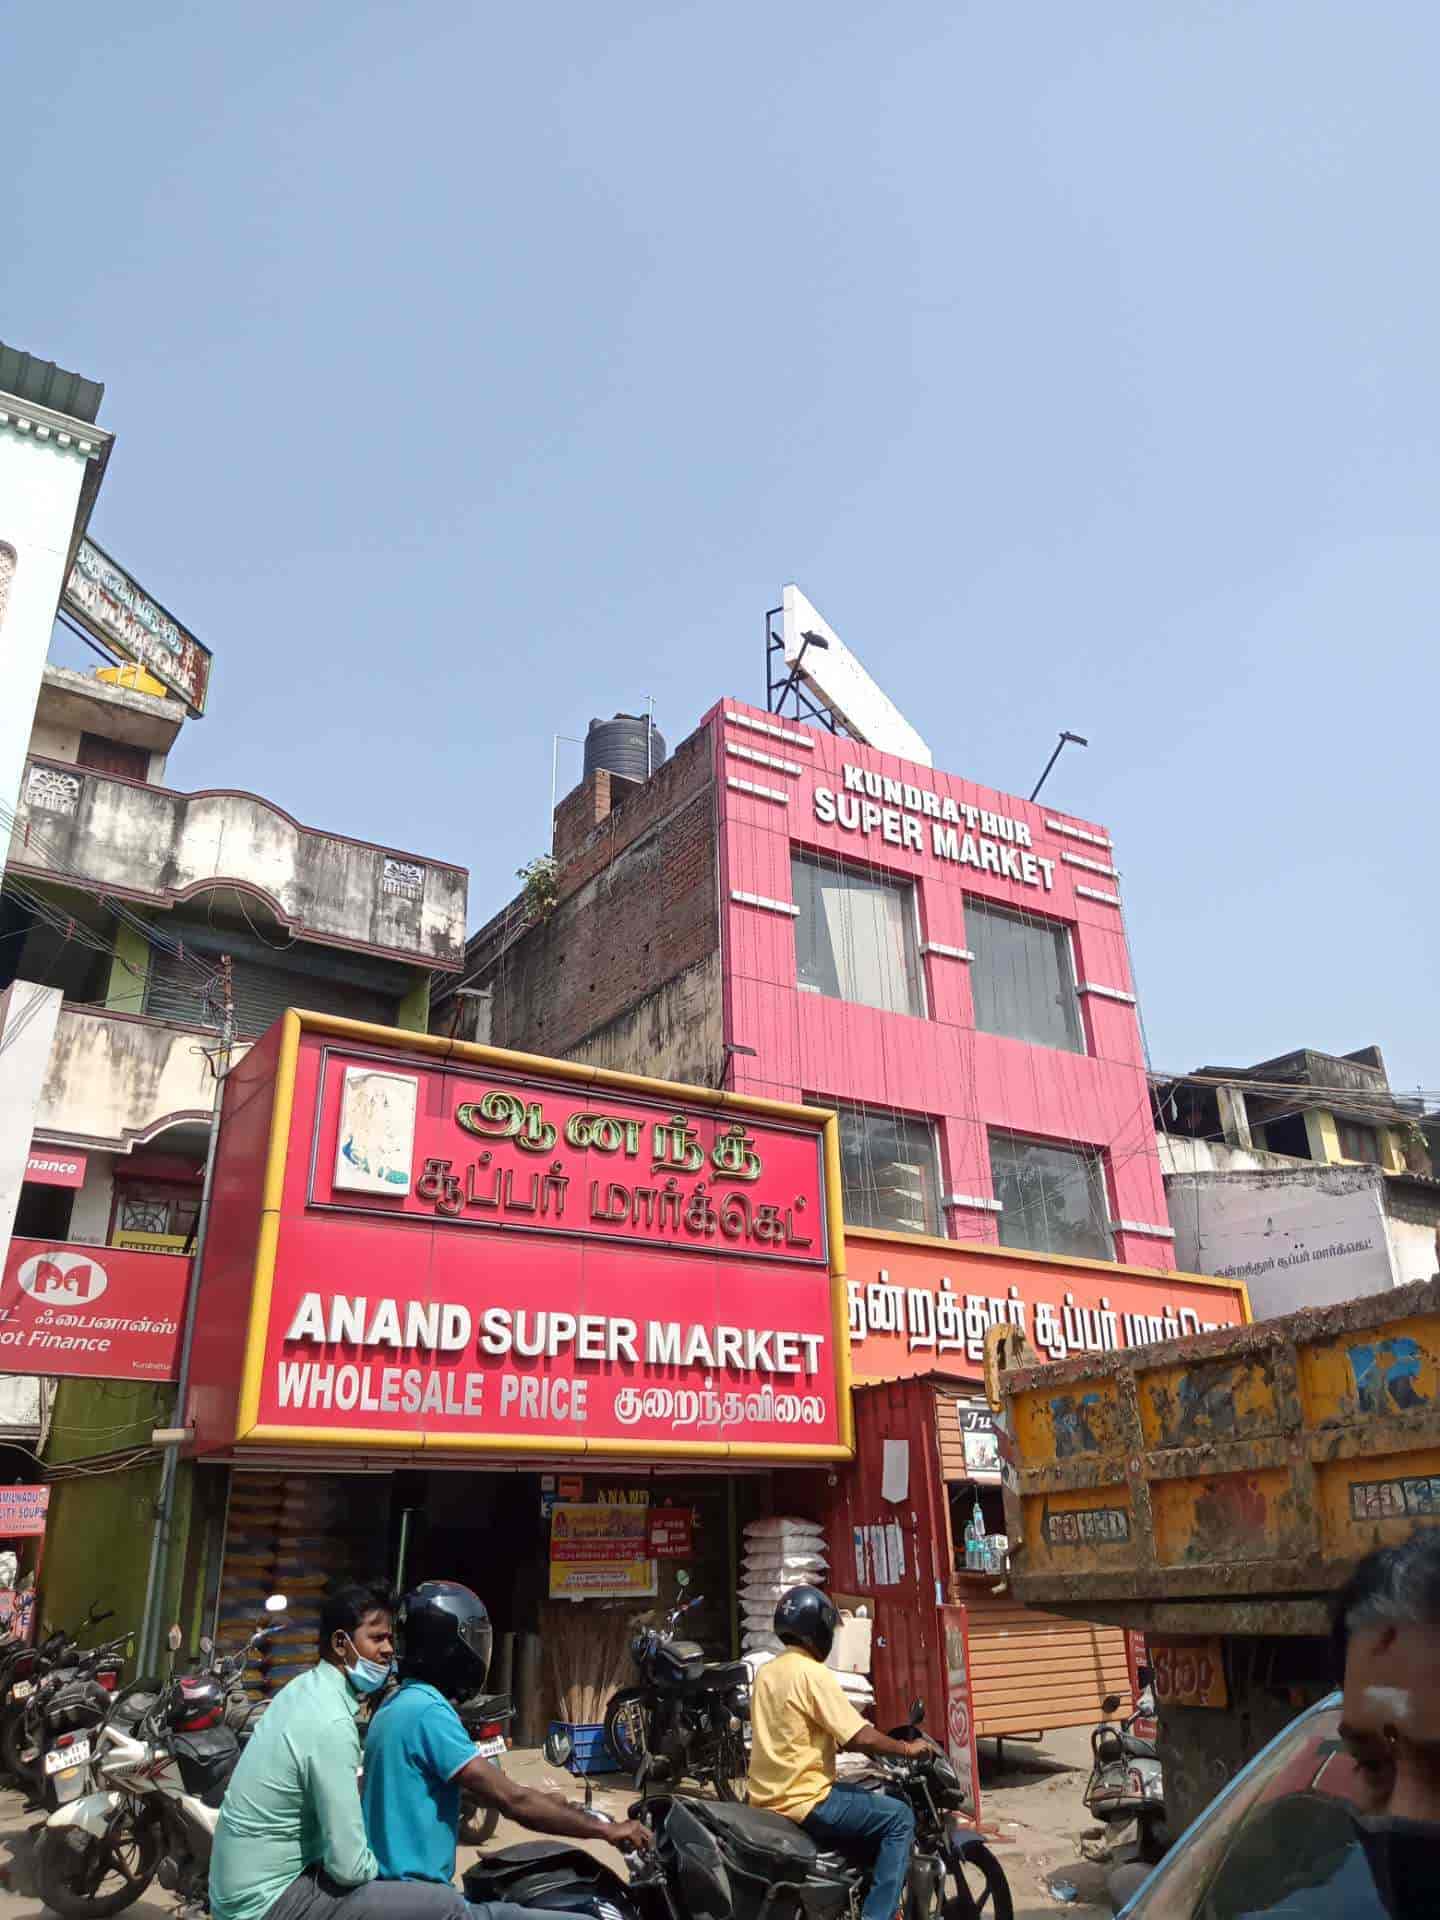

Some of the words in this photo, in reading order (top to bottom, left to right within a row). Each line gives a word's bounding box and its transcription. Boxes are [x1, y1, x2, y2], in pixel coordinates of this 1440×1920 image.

[814, 789, 923, 851] SUPER
[932, 822, 1055, 890] MARKET
[843, 763, 1032, 847] KUNDRATHUR
[456, 1090, 763, 1181] ஆனந்த்
[416, 1151, 569, 1215] சூப்பர்
[590, 1177, 812, 1249] மார்க்கெட்
[0, 1330, 26, 1347] ot
[28, 1331, 112, 1352] Finance
[284, 1292, 471, 1350] ANAND
[479, 1308, 640, 1363] SUPER
[645, 1320, 825, 1375] MARKET
[277, 1361, 484, 1417] WHOLESALE
[499, 1374, 588, 1421] PRICE
